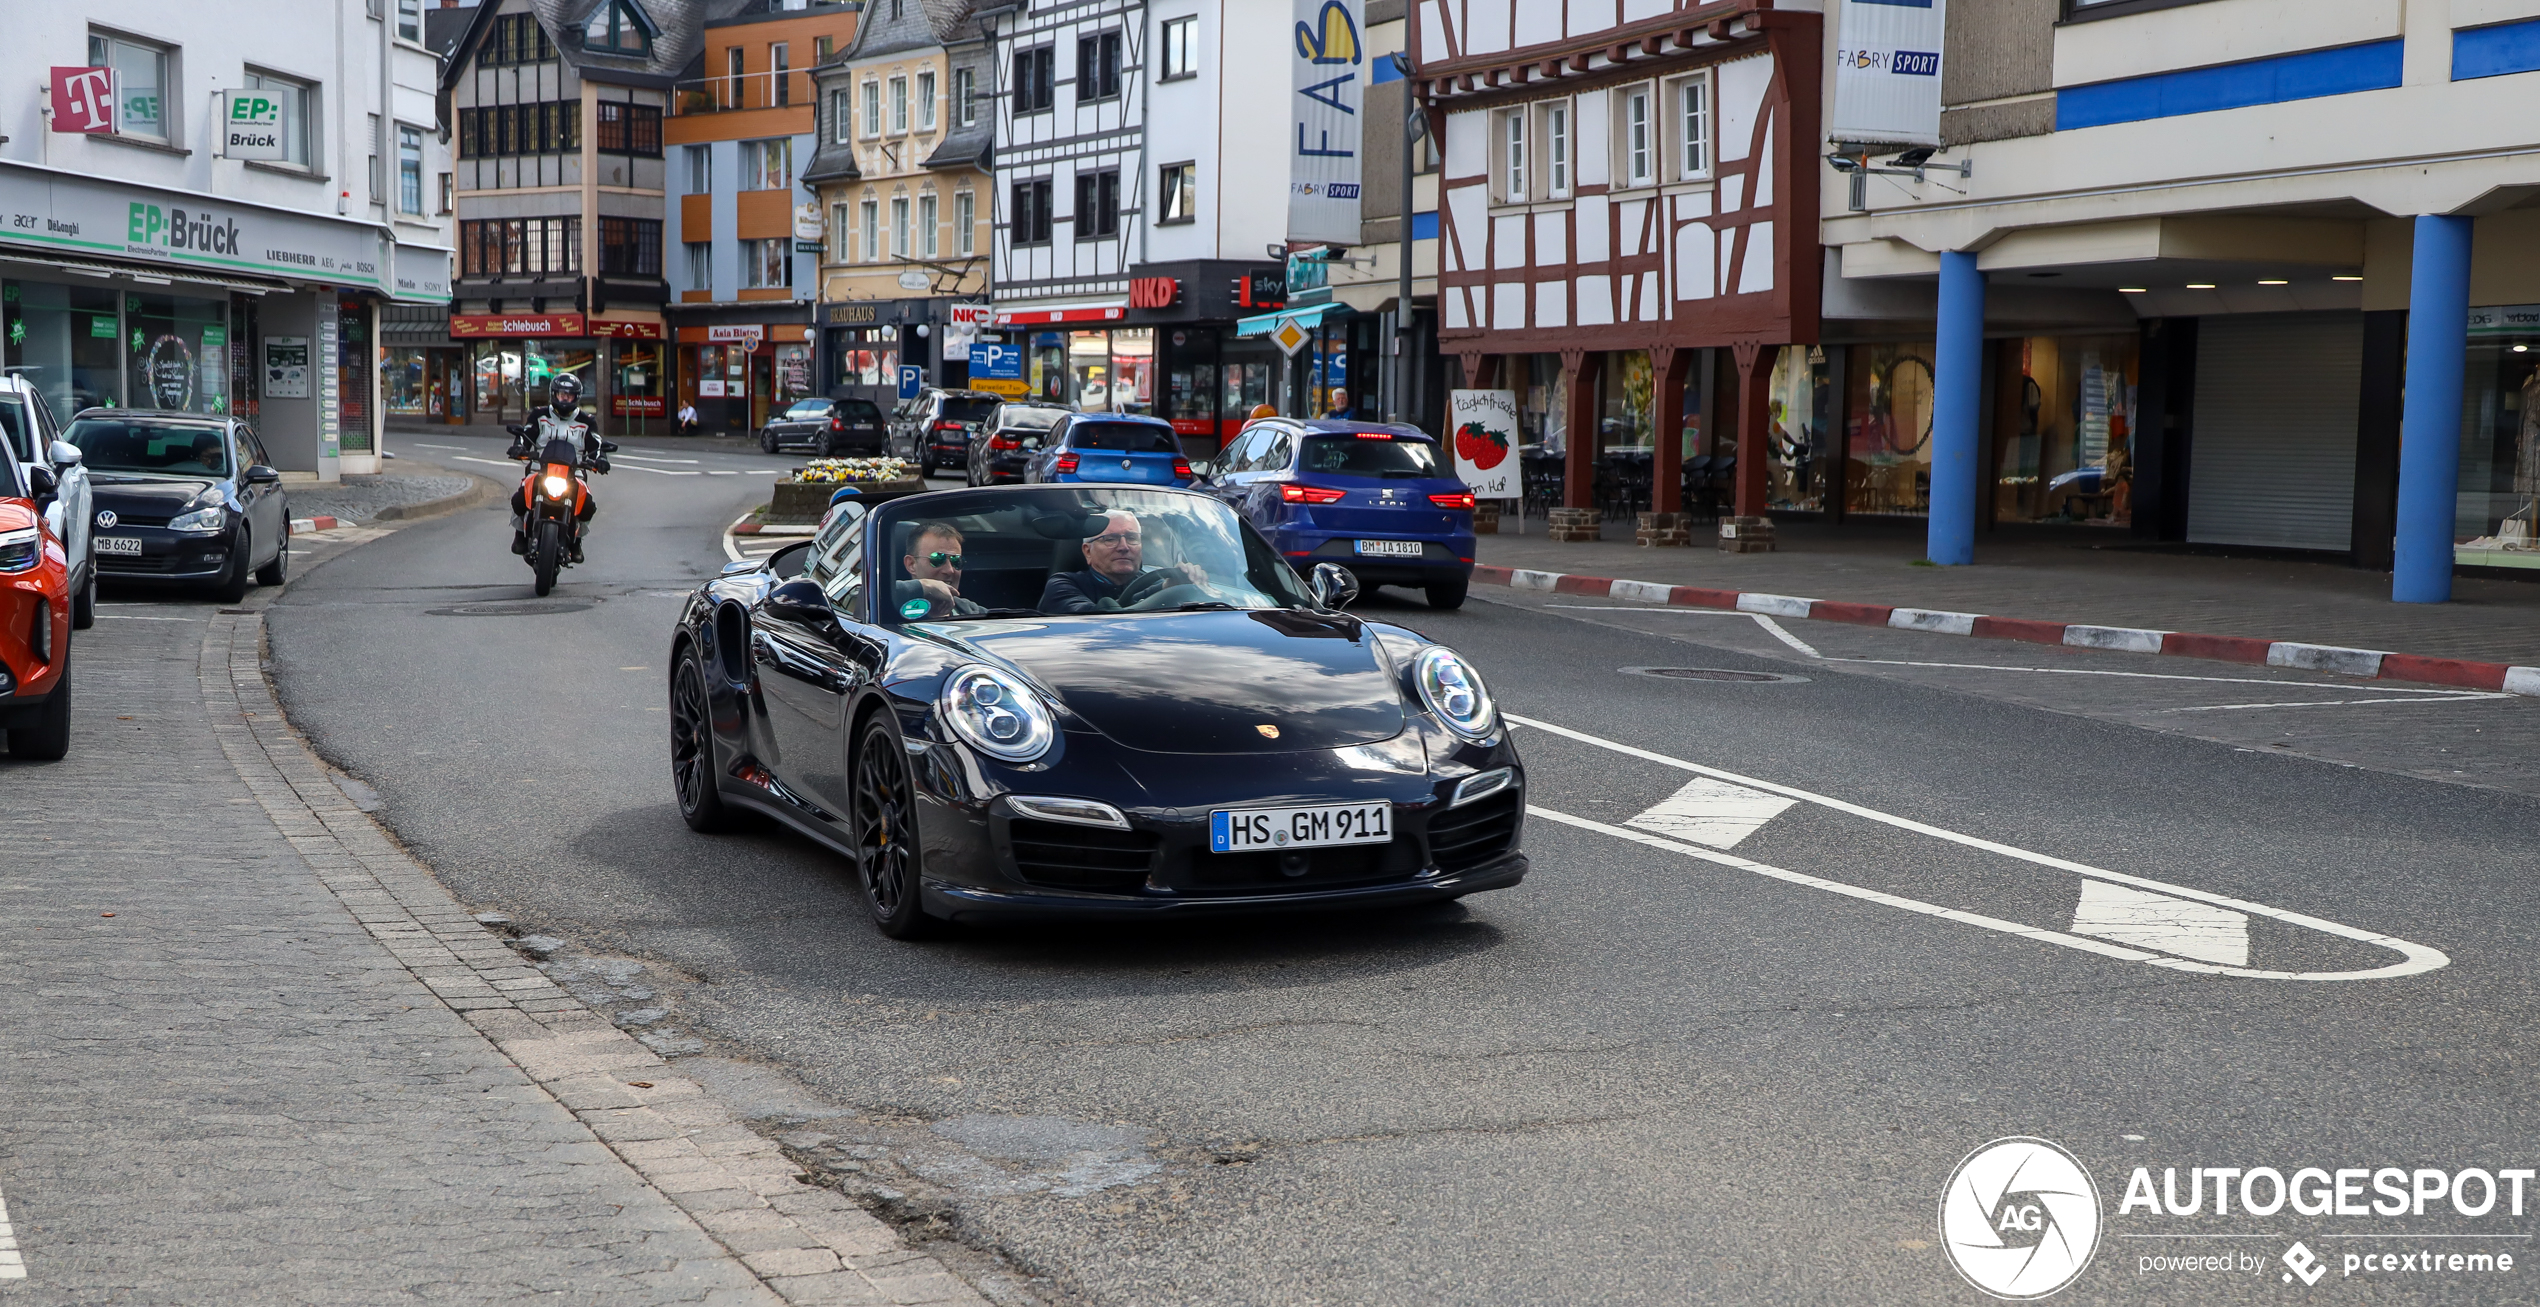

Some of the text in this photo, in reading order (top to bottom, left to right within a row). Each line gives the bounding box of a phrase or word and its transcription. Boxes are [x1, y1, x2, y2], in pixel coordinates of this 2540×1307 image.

[1837, 50, 1936, 73] FABRY SPORT
[231, 98, 278, 120] EP:
[230, 133, 276, 147] Brück
[1290, 183, 1359, 198] FABRY SPORT
[14, 214, 38, 229] acer
[267, 249, 316, 266] LIEBHERR
[321, 257, 335, 269] AEG
[356, 262, 375, 274] BOSCH
[128, 245, 168, 257] ElectronicPartner
[397, 278, 442, 293] Miele SONY
[1130, 276, 1176, 308] NKD
[1254, 277, 1284, 295] sky
[830, 305, 876, 323] BRAUHAUS
[998, 314, 1012, 324] NKD
[1050, 311, 1063, 321] NKD
[1105, 308, 1119, 319] NKD
[503, 319, 551, 332] Schlebusch
[713, 328, 759, 338] Asia Bistro
[988, 345, 1003, 368] P
[1808, 356, 1826, 365] adidas
[903, 369, 916, 389] P
[1488, 476, 1507, 493] Hof
[97, 539, 140, 552] MB 6622
[1362, 541, 1420, 554] BM IA 1810
[1232, 807, 1388, 845] HS GM 911
